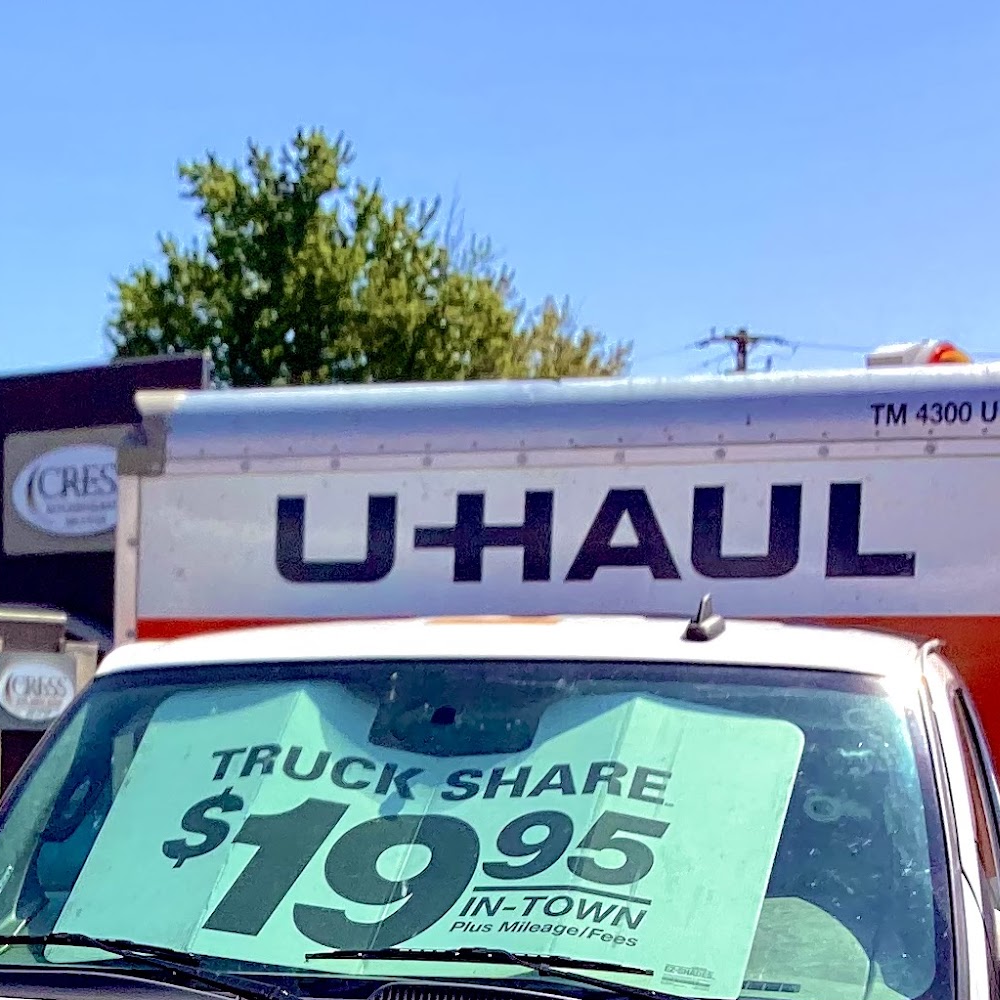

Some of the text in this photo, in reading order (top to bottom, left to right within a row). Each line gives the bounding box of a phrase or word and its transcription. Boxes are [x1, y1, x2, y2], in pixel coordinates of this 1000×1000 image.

[870, 400, 999, 426] TM 4300 U
[275, 482, 917, 584] U-HAUL
[211, 743, 673, 805] TRUCK SHARE
[458, 895, 648, 931] IN-TOWN
[449, 920, 638, 948] Plus Mileage/Fees
